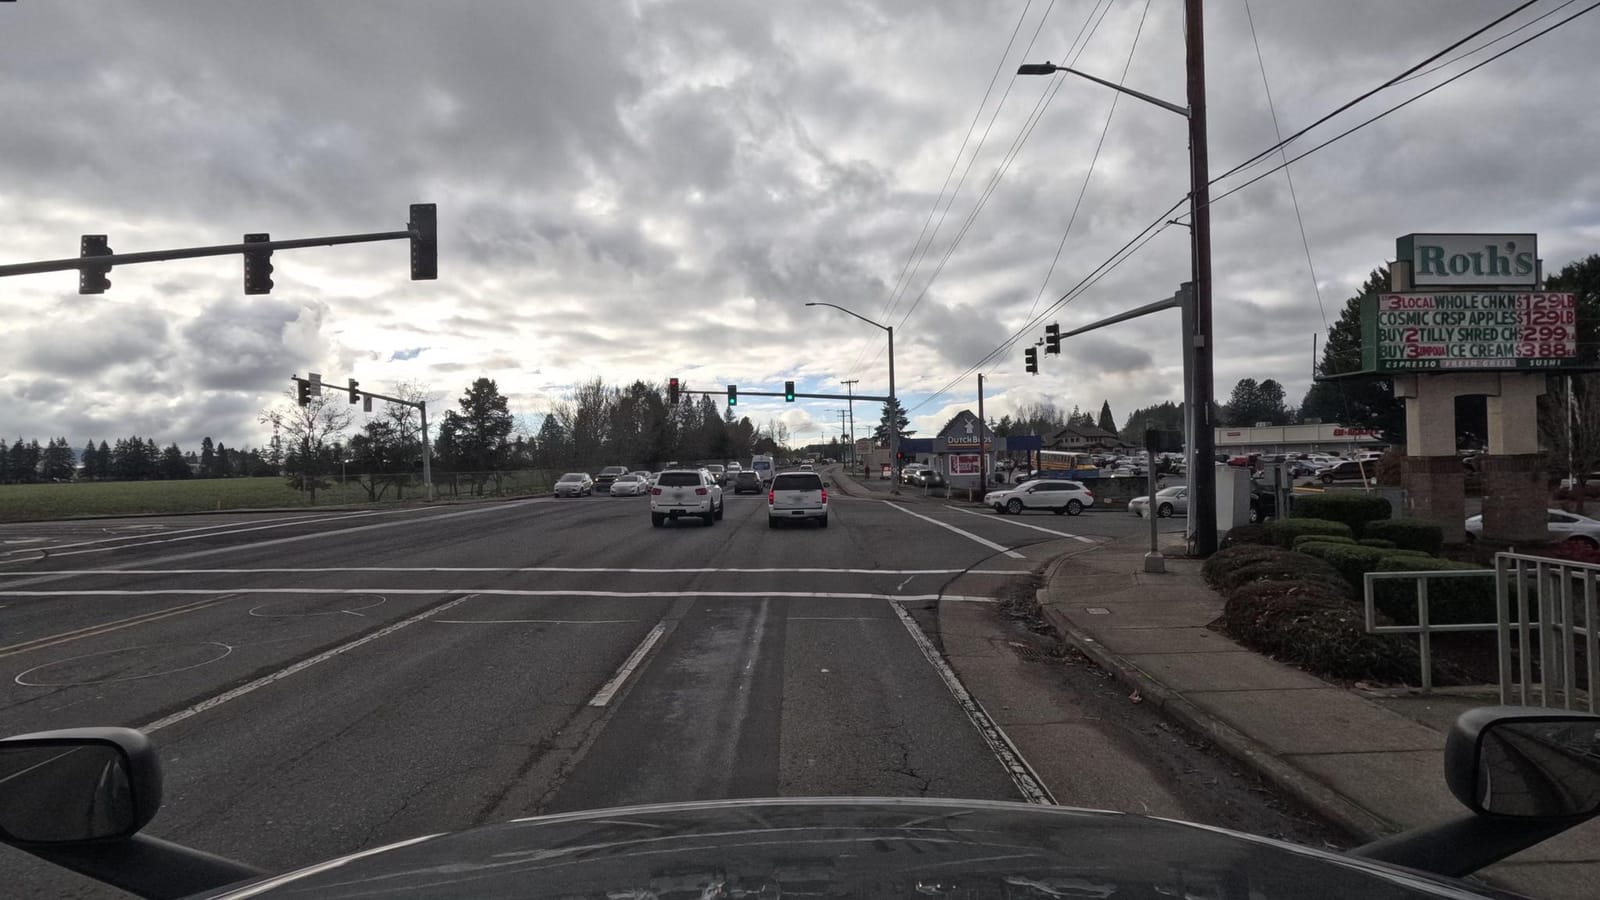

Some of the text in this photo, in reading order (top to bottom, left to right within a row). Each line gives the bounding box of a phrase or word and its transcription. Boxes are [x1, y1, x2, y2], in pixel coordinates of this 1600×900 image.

[1416, 241, 1533, 277] Roth's
[1388, 295, 1402, 309] 3
[1402, 297, 1434, 309] LOCAL
[1434, 295, 1479, 309] WHOLE
[1481, 295, 1516, 309] CHKN
[1379, 311, 1429, 326] COSMIC
[1432, 311, 1466, 325] CRSP
[1468, 311, 1517, 325] APPLES
[1379, 328, 1405, 342] BUY
[1405, 327, 1419, 343] 2
[1419, 328, 1455, 342] TILLY
[1457, 327, 1499, 341] SHRED
[1501, 327, 1517, 341] CH
[1379, 344, 1405, 358] BUY
[1406, 344, 1419, 358] 3
[1445, 344, 1467, 358] ICE
[1469, 344, 1514, 357] CREAM
[1385, 360, 1437, 369] ESPRESSO
[1529, 359, 1561, 367] SUSHI
